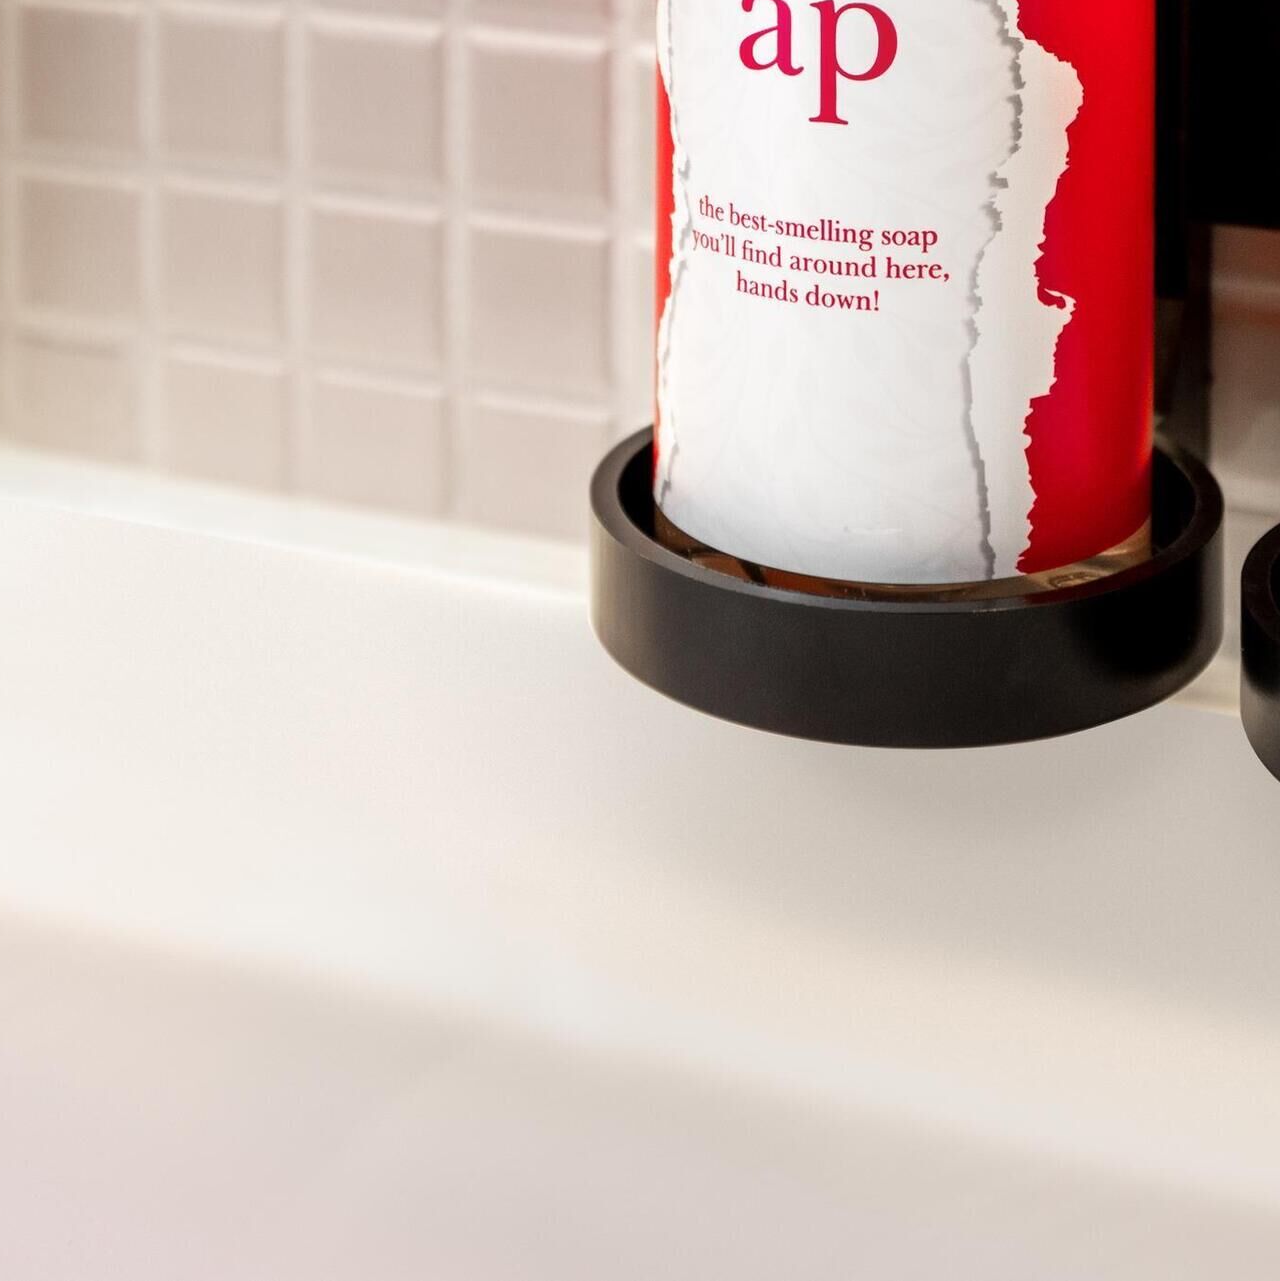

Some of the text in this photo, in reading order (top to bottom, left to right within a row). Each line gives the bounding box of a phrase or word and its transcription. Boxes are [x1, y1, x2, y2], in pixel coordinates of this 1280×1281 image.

[698, 195, 939, 254] the best-smelling soap
[692, 228, 950, 282] you’ll find around here,
[736, 270, 880, 312] hands down!
